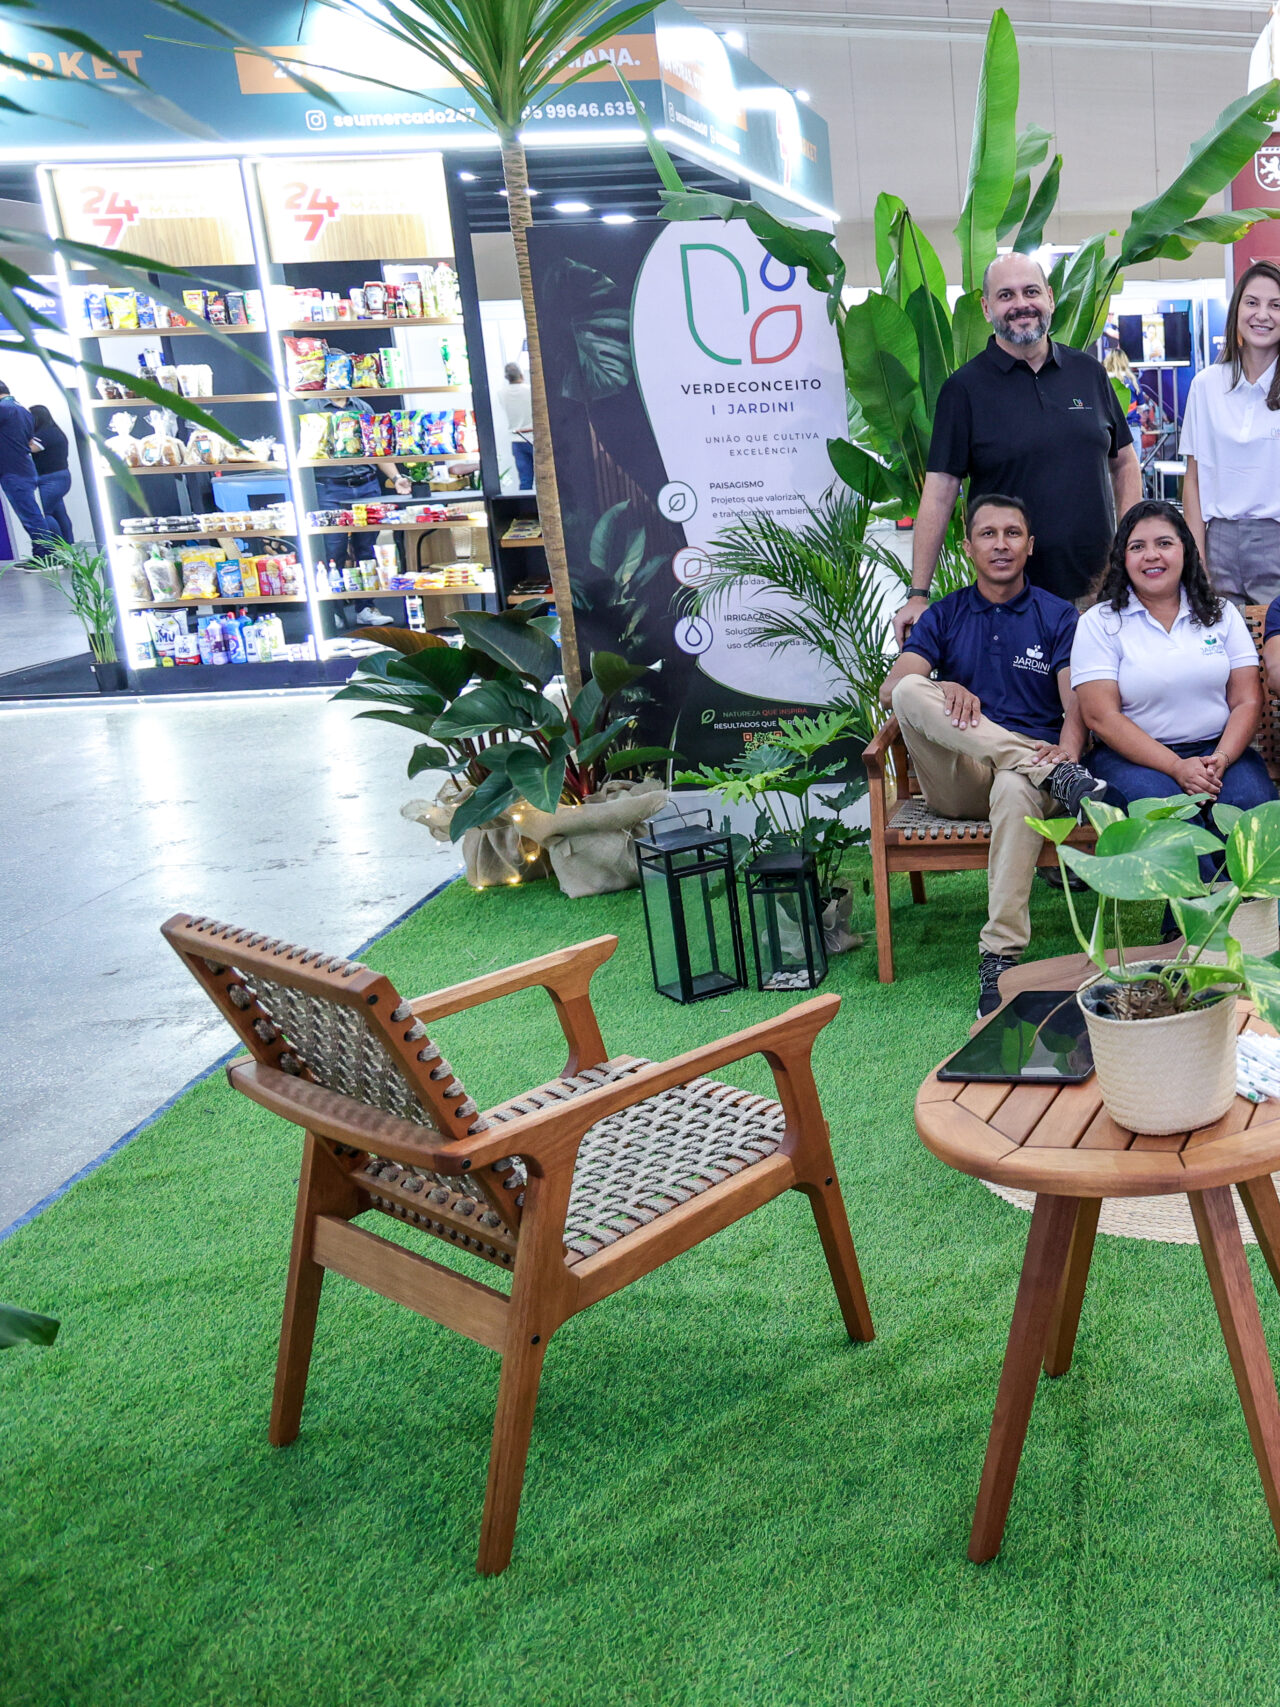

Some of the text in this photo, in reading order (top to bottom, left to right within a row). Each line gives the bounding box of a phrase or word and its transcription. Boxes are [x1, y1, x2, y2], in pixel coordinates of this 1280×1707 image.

[333, 107, 477, 127] seumercado247
[680, 378, 822, 395] VERDECONCEITO
[728, 401, 795, 415] JARDINI
[705, 431, 820, 444] UNIÃO QUE CULTIVA
[729, 445, 798, 457] EXCELÊNCIA
[709, 480, 765, 490] PAISAGISMO
[711, 493, 806, 505] Projetos que valorizam
[750, 577, 766, 586] das
[1013, 655, 1050, 672] JARDINI
[723, 707, 808, 718] NATUREZA QUE INSPIRA
[714, 721, 760, 730] RESULTADOS
[761, 720, 777, 728] QUE
